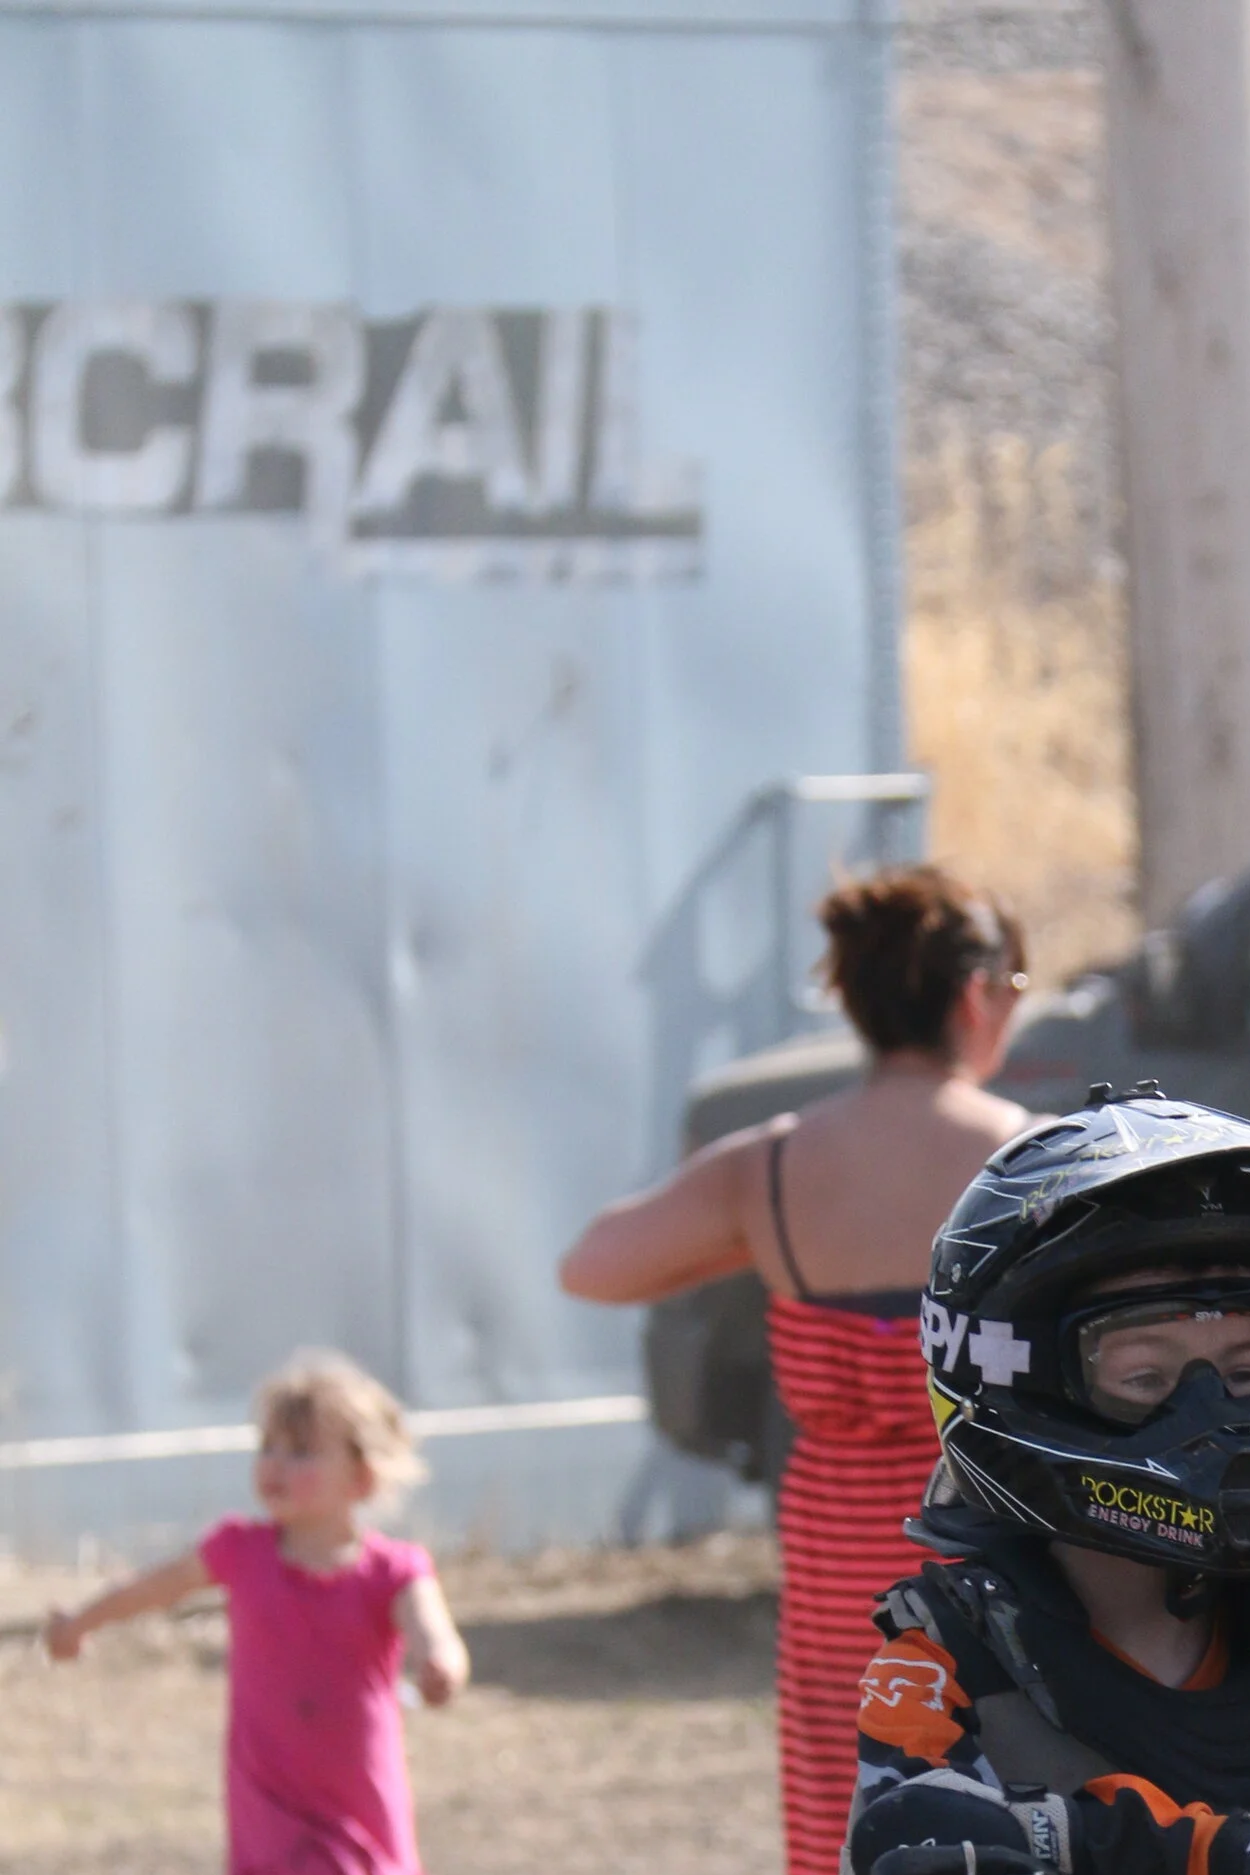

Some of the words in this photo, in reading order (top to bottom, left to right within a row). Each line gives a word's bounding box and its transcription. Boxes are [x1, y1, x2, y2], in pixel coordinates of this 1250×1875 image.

[0, 300, 703, 522] CRAIL
[1088, 1504, 1151, 1533] ENERGY
[1157, 1522, 1204, 1547] DRINK
